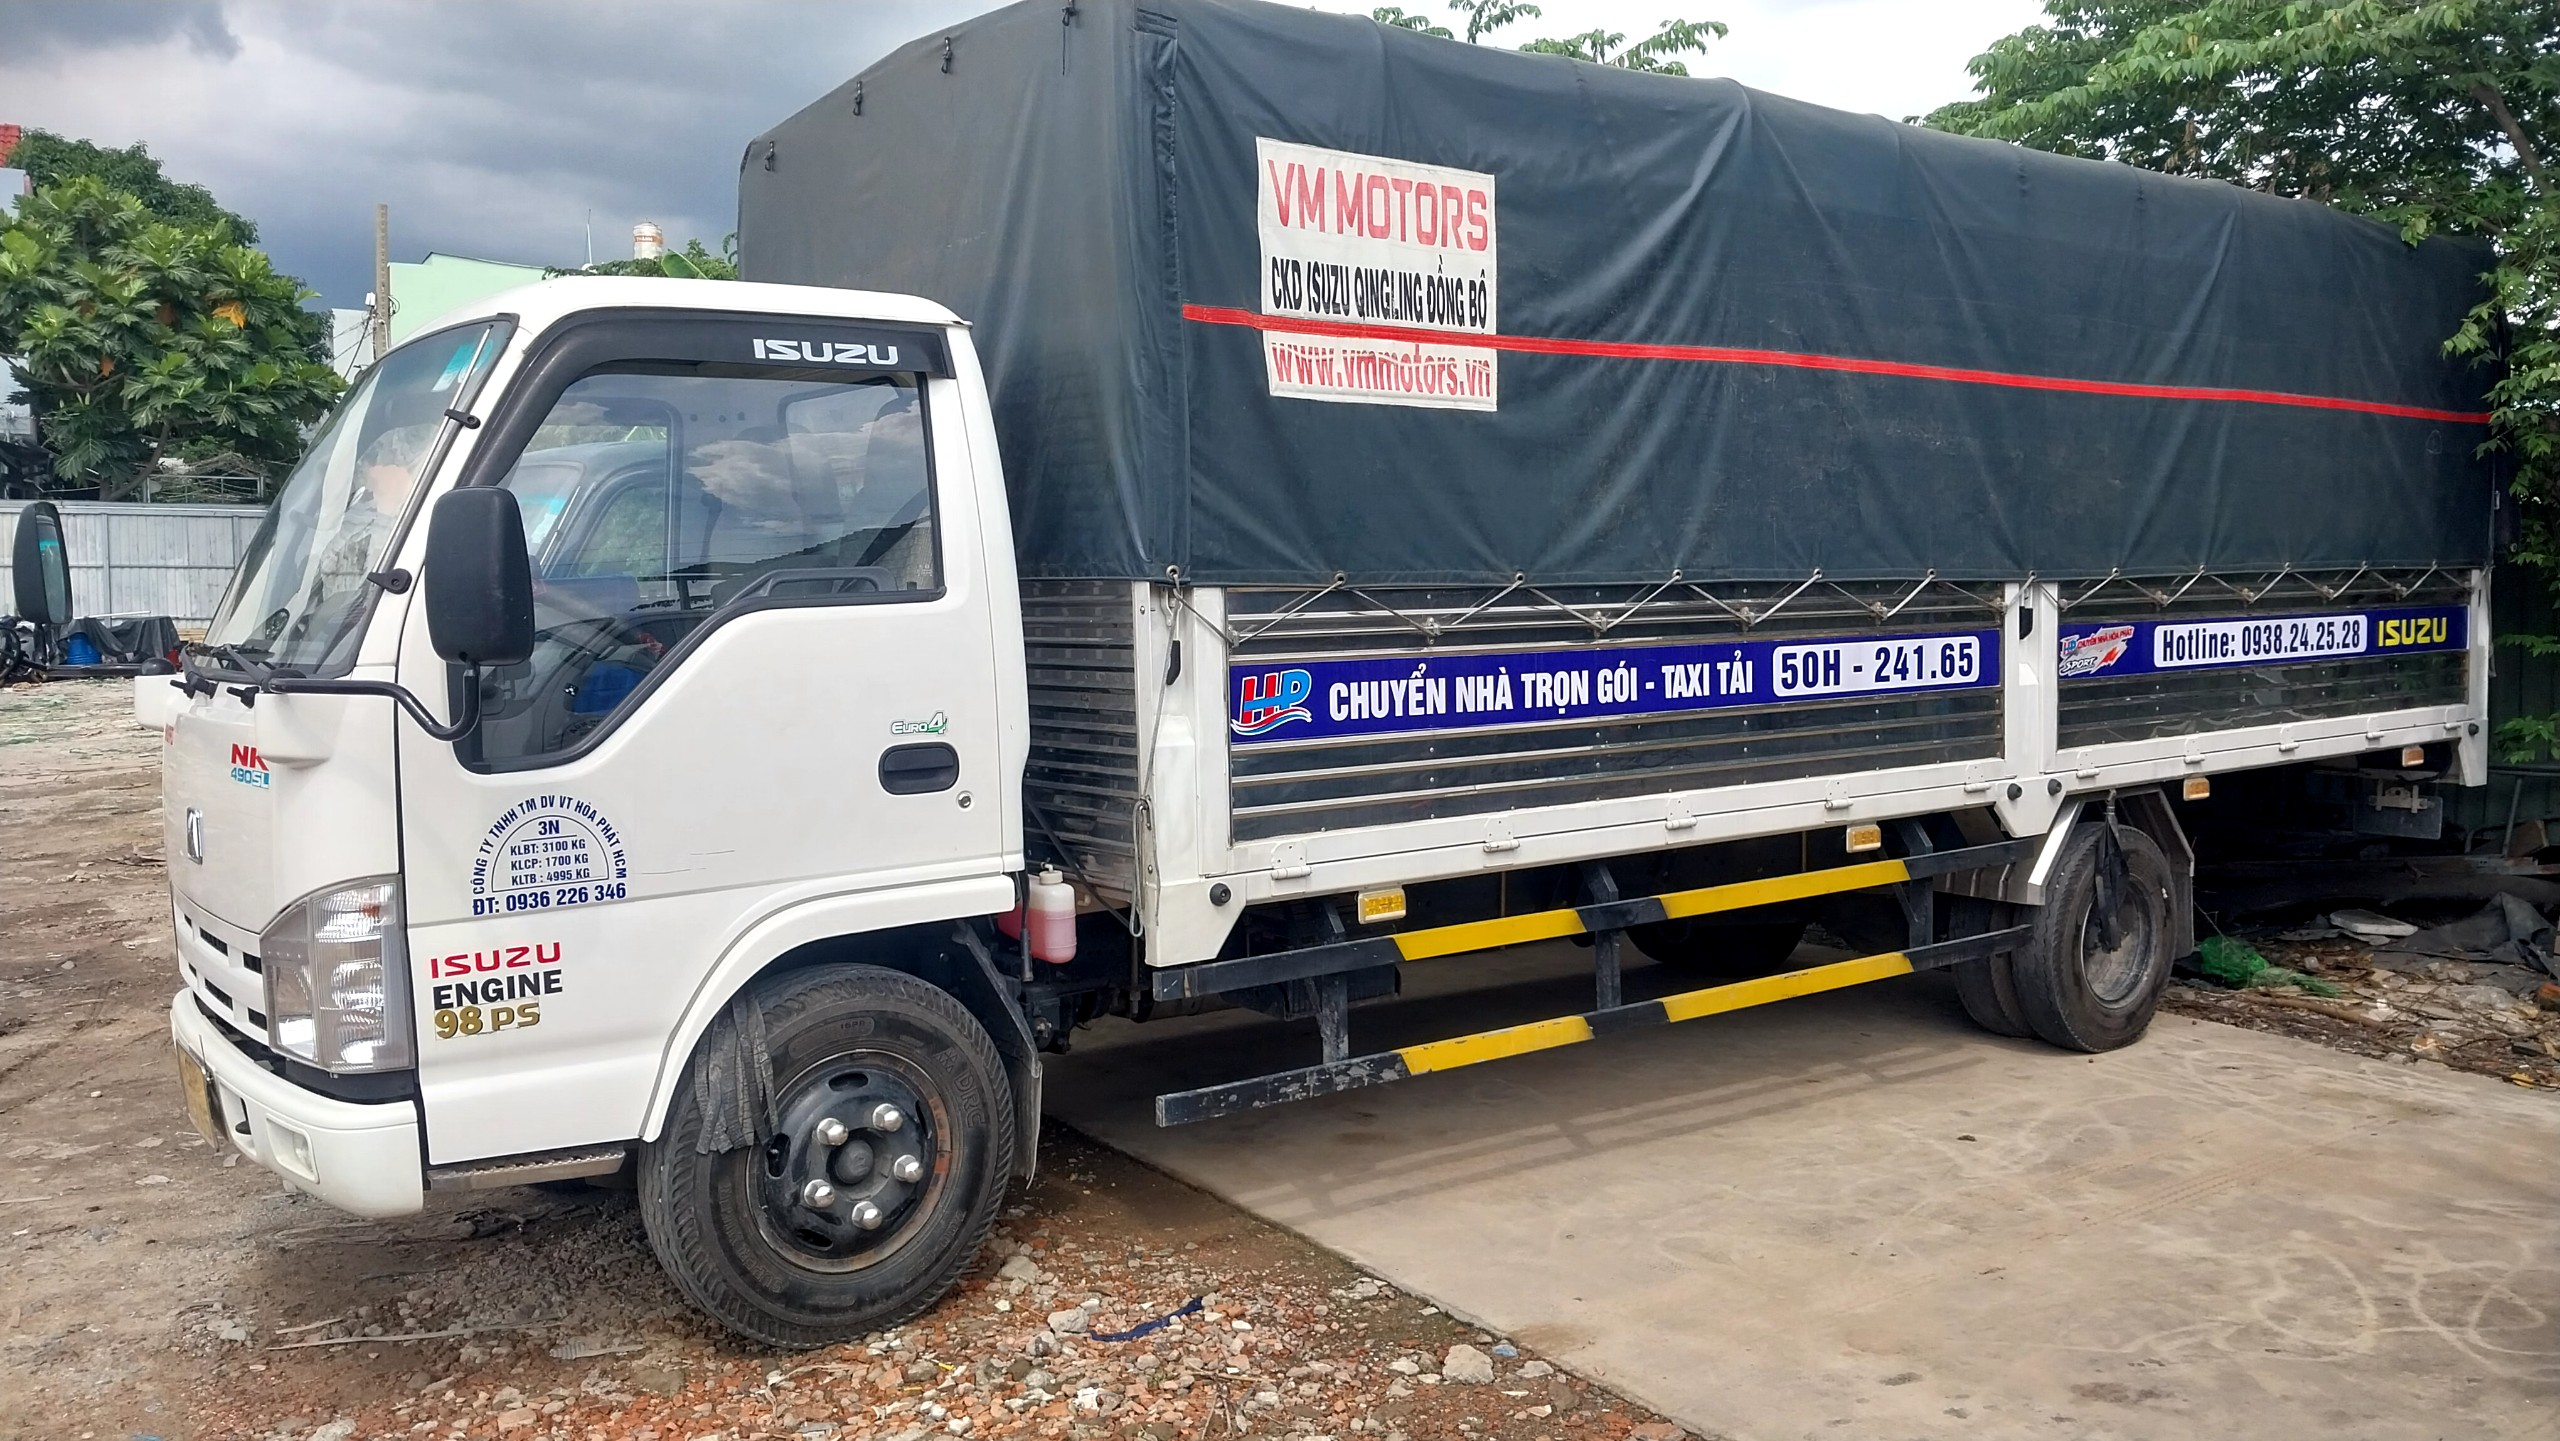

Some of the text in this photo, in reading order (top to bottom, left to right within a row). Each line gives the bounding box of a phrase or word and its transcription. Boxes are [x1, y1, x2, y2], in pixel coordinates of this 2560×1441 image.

[1267, 159, 1488, 251] VM MOTORS
[1271, 256, 1303, 310] CKD
[1307, 261, 1350, 317] ISUZU
[1354, 266, 1423, 323] QINGLING
[1427, 254, 1465, 327] ĐỒNG
[753, 338, 899, 365] ISUZU
[1271, 343, 1491, 397] www.vmmotors.vn
[2163, 620, 2360, 662] Hotline: 0938.24.25.28
[2378, 617, 2447, 647] ISUZU
[1781, 650, 1840, 690] 50H
[1875, 642, 1973, 683] 241.65
[2063, 656, 2098, 673] SPORT
[1329, 663, 1446, 721] CHUYỂN
[1456, 667, 1513, 713] NHÀ
[1521, 670, 1589, 714] TRỌN
[1597, 660, 1638, 703] GÓI
[1662, 663, 1710, 699] TAXI
[1716, 650, 1753, 694] TẢI
[231, 767, 270, 789] 490SL
[470, 795, 627, 895] CÔNG TY TNHH TM DV VT HÒA PHÁT HCM
[538, 820, 560, 836] 3N
[510, 839, 586, 856] KLBT: 3100 KG
[510, 853, 589, 871] KLCP: 1700 KG
[511, 873, 537, 886] KLTB
[546, 869, 573, 882] 4995
[576, 868, 590, 879] KG
[472, 882, 627, 916] ĐT: 0936 226 346
[430, 942, 560, 979] ISUZU
[433, 969, 563, 1010] ENGINE
[435, 1002, 541, 1039] 98 PS
[953, 1070, 986, 1128] DRC
